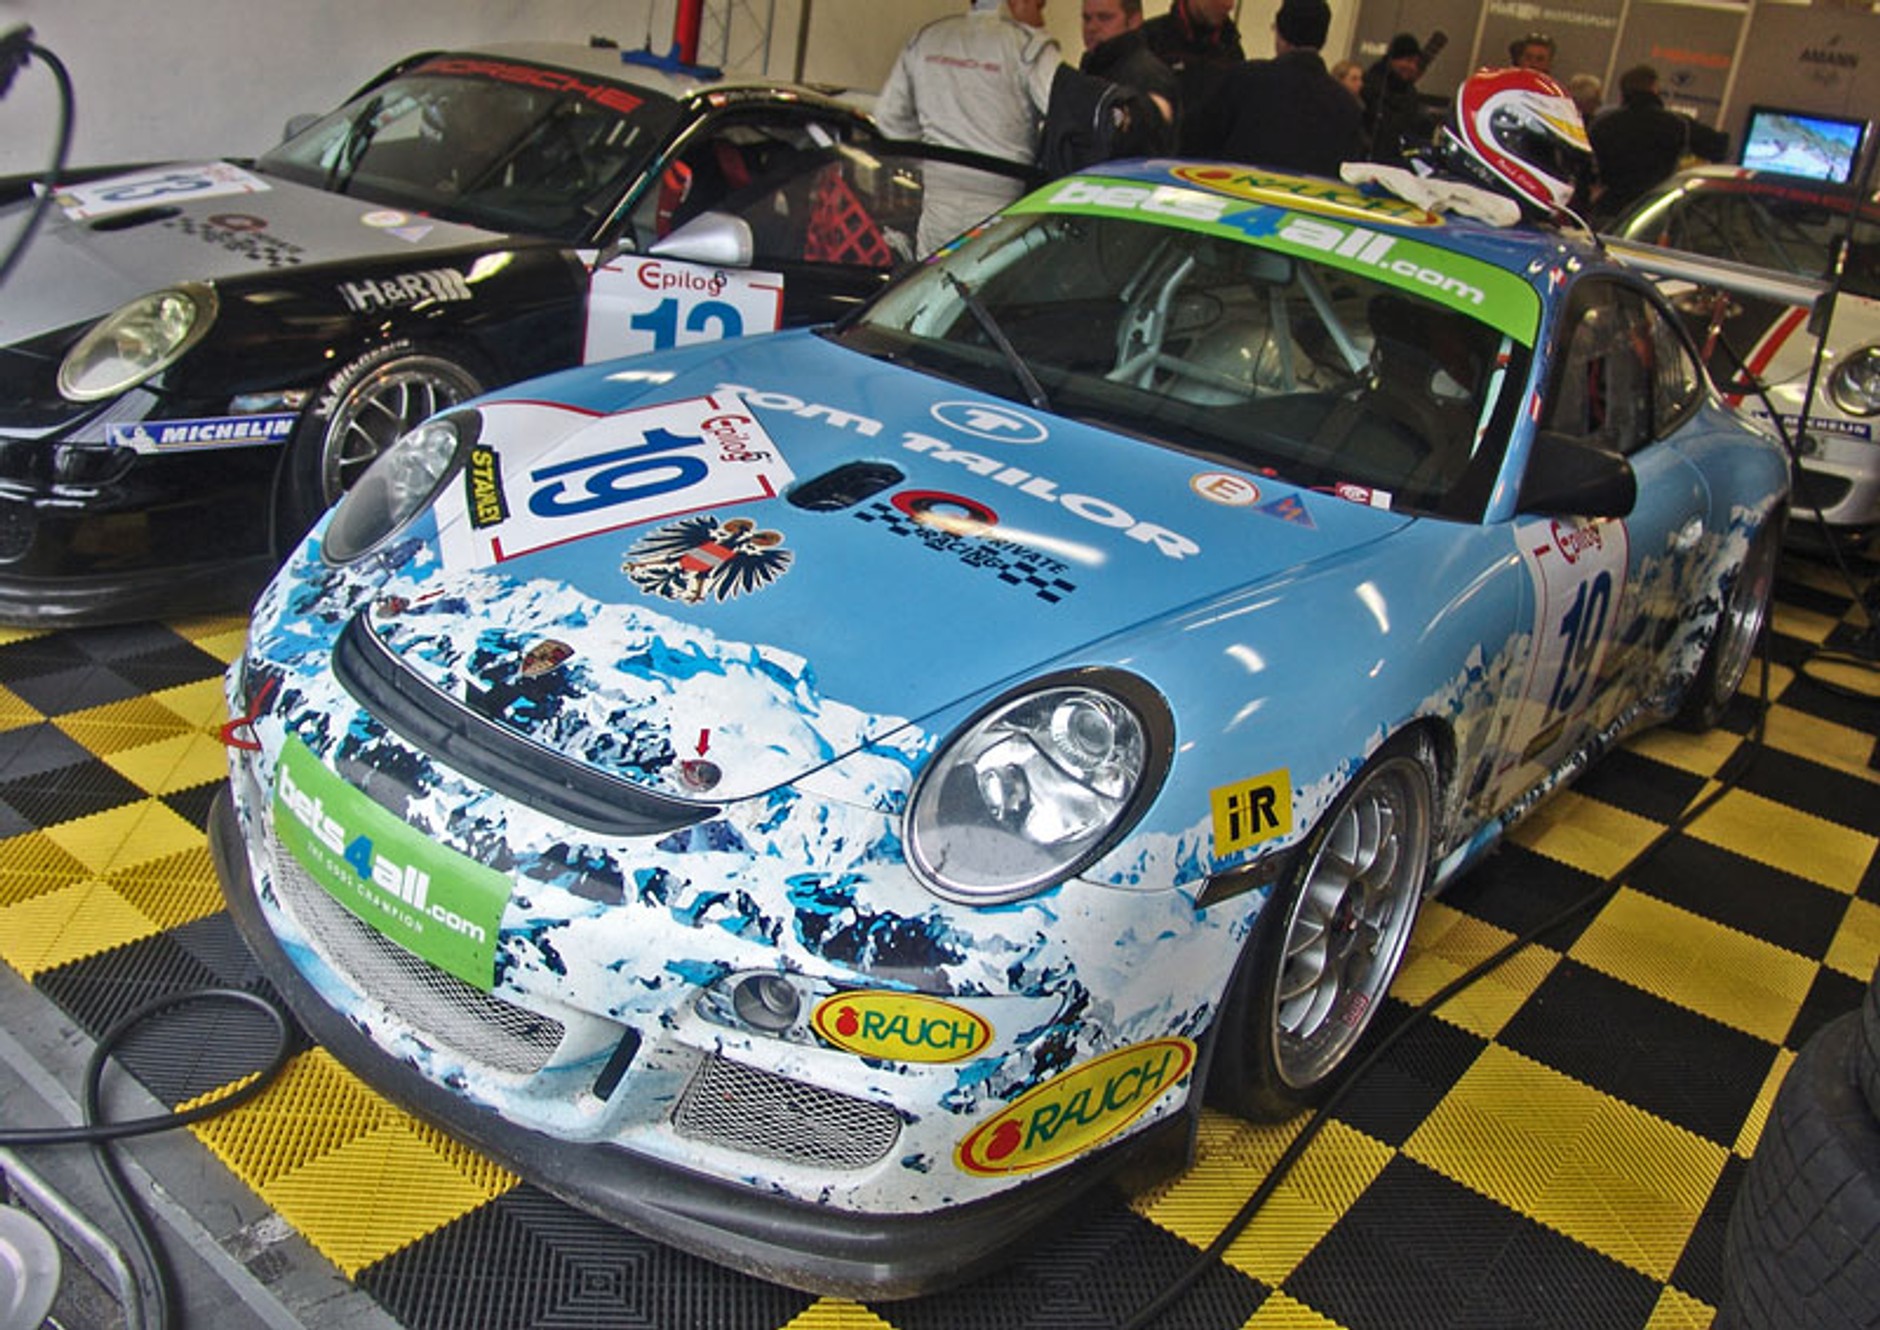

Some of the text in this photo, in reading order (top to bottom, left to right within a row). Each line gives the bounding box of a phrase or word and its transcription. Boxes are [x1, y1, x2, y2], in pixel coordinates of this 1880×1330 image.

[161, 419, 294, 444] MICHELIN
[528, 427, 709, 518] 19
[902, 431, 1200, 560] TAILOR
[1540, 570, 1612, 728] 19
[279, 764, 487, 944] bets4all.com
[862, 1010, 976, 1050] RAUCH
[1023, 1051, 1172, 1150] RAUCH
